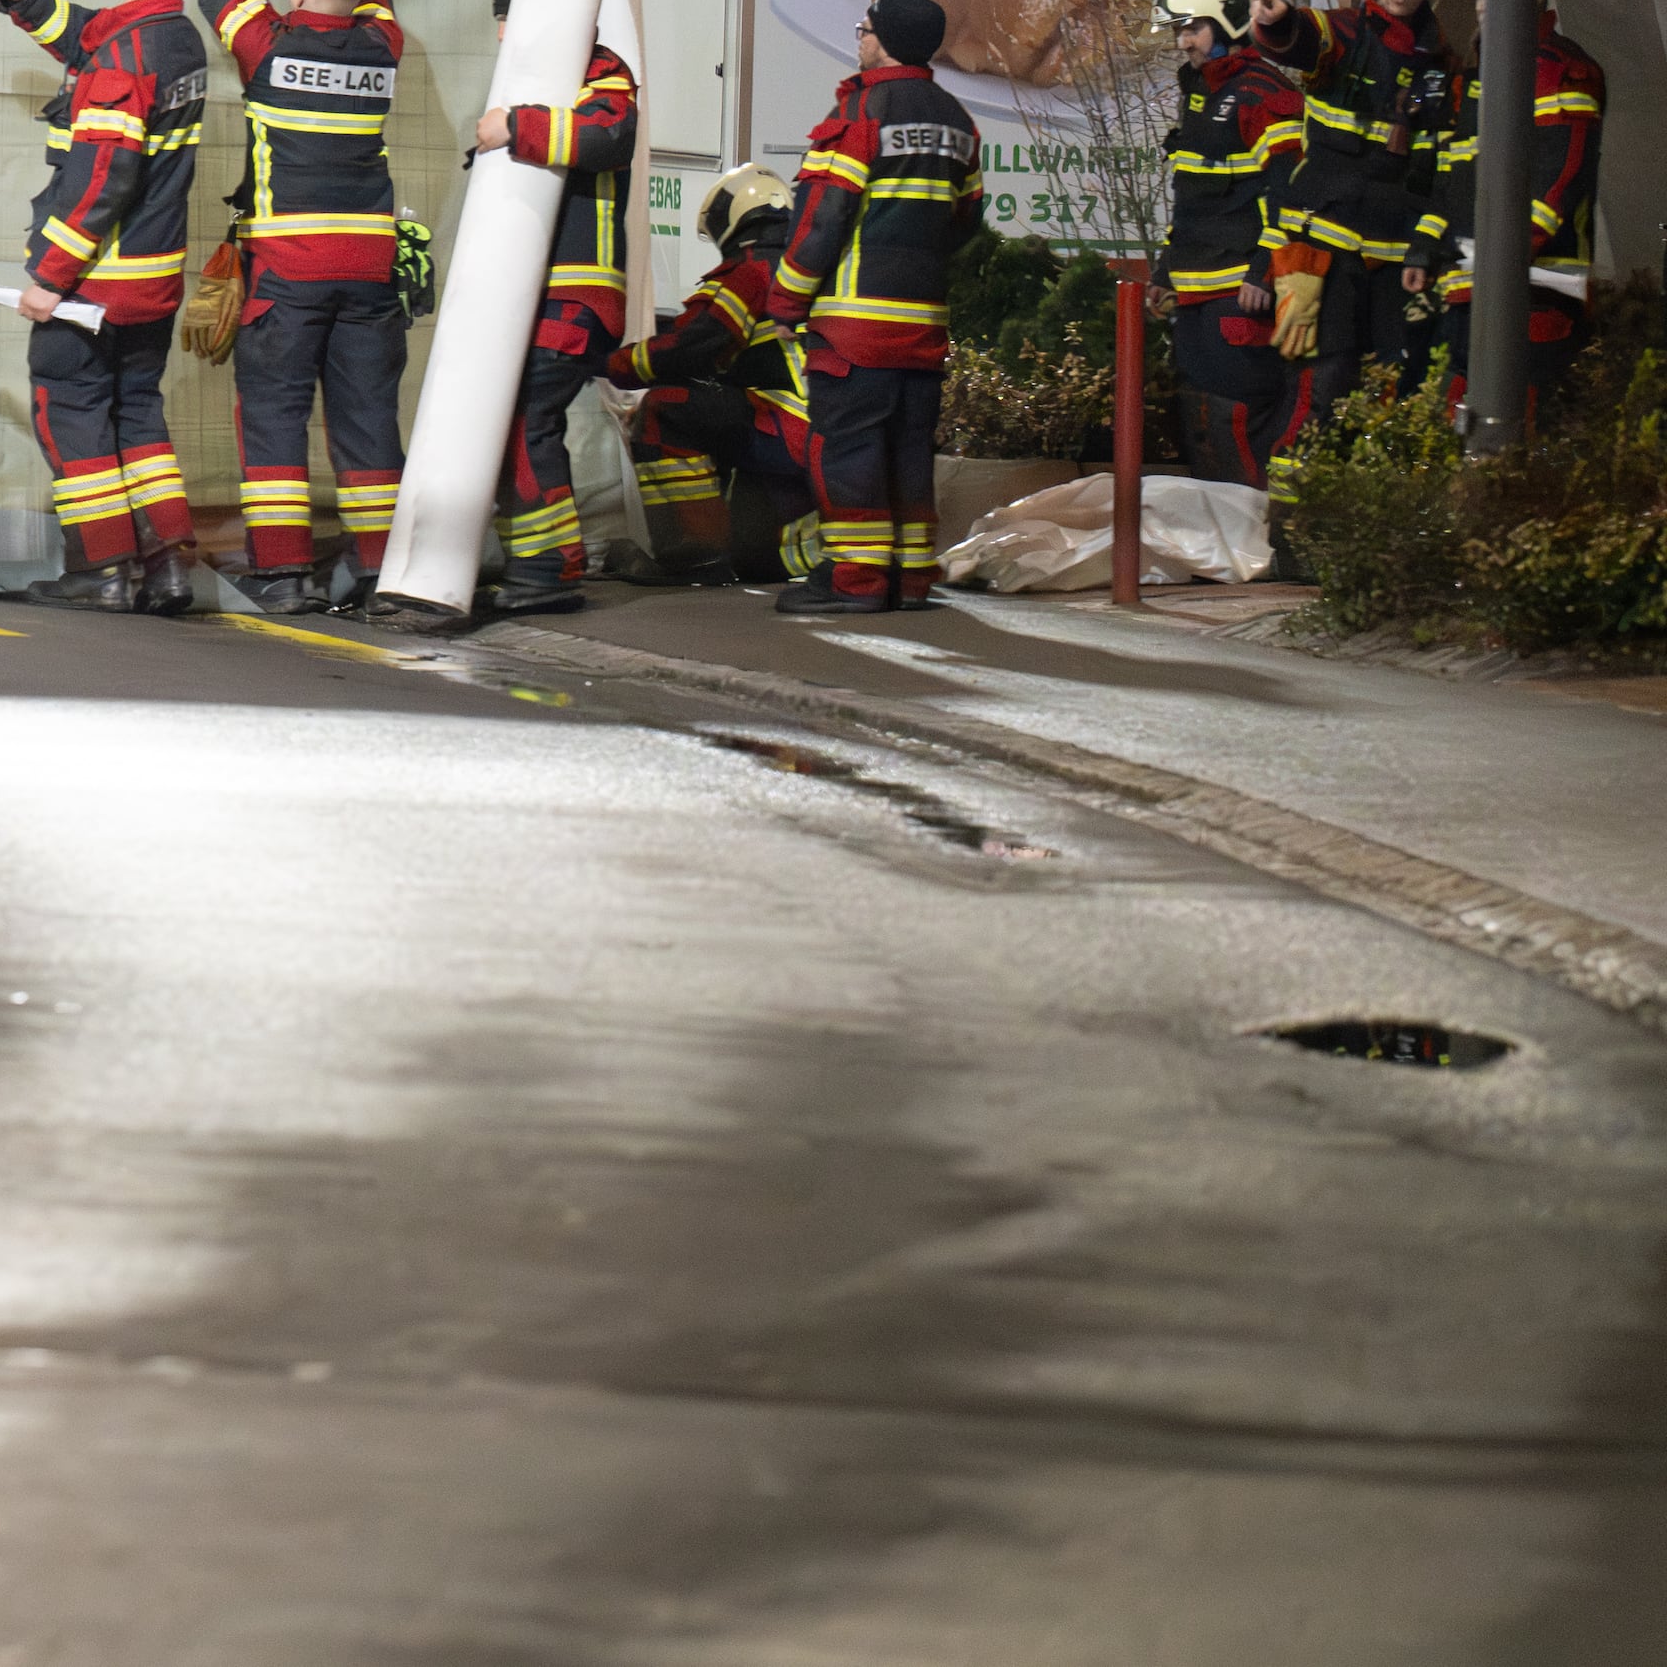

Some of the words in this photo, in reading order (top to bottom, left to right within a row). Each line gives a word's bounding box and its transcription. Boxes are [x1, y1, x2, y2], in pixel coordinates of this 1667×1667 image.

[983, 143, 1158, 175] ILLWAREN
[649, 176, 682, 210] EBAB
[1030, 194, 1098, 223] 317
